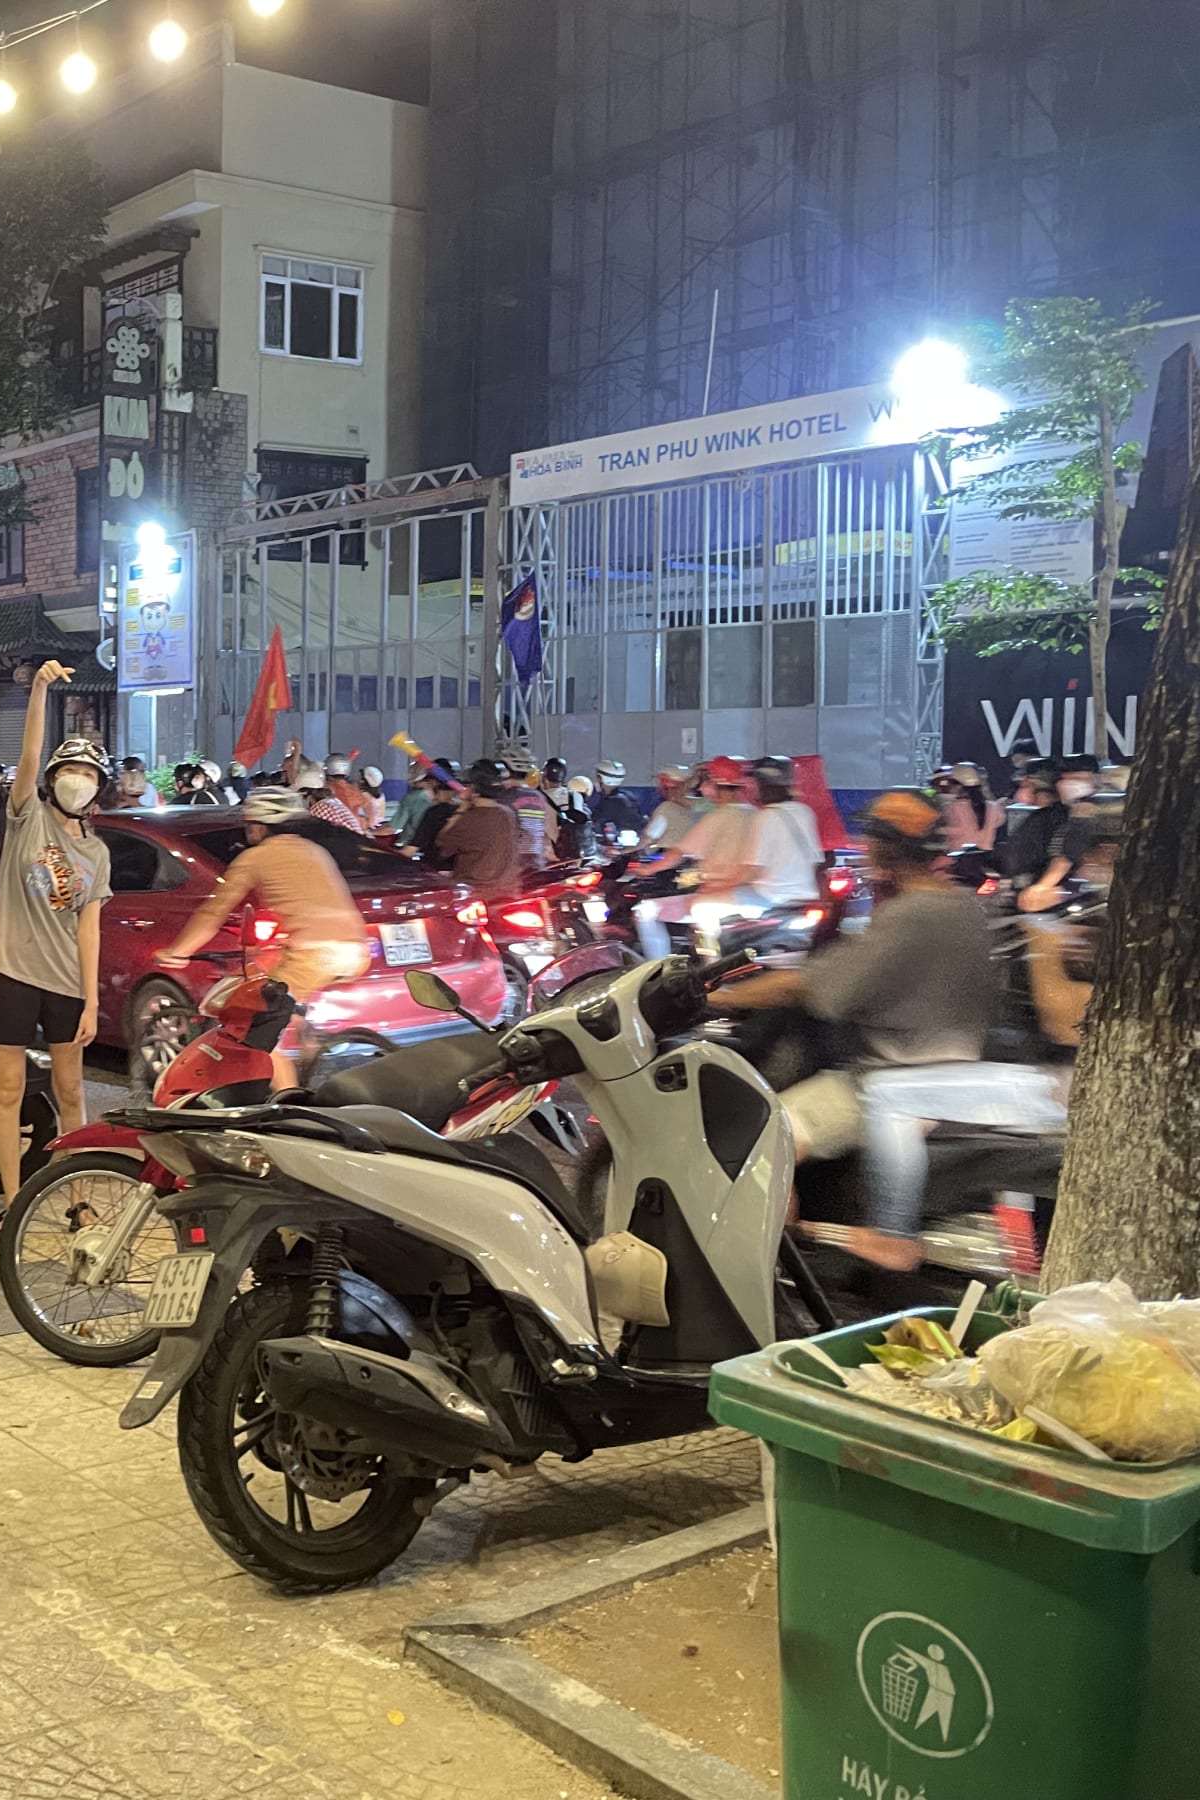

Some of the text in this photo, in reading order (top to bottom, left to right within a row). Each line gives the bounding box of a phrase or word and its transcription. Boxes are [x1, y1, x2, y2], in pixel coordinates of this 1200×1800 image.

[104, 395, 149, 439] KIM
[598, 447, 650, 473] TRAN
[656, 438, 699, 463] PHU
[704, 426, 764, 454] WINK
[769, 412, 848, 444] HOTEL
[161, 1257, 203, 1288] 43-C1
[148, 1291, 197, 1323] 701.64
